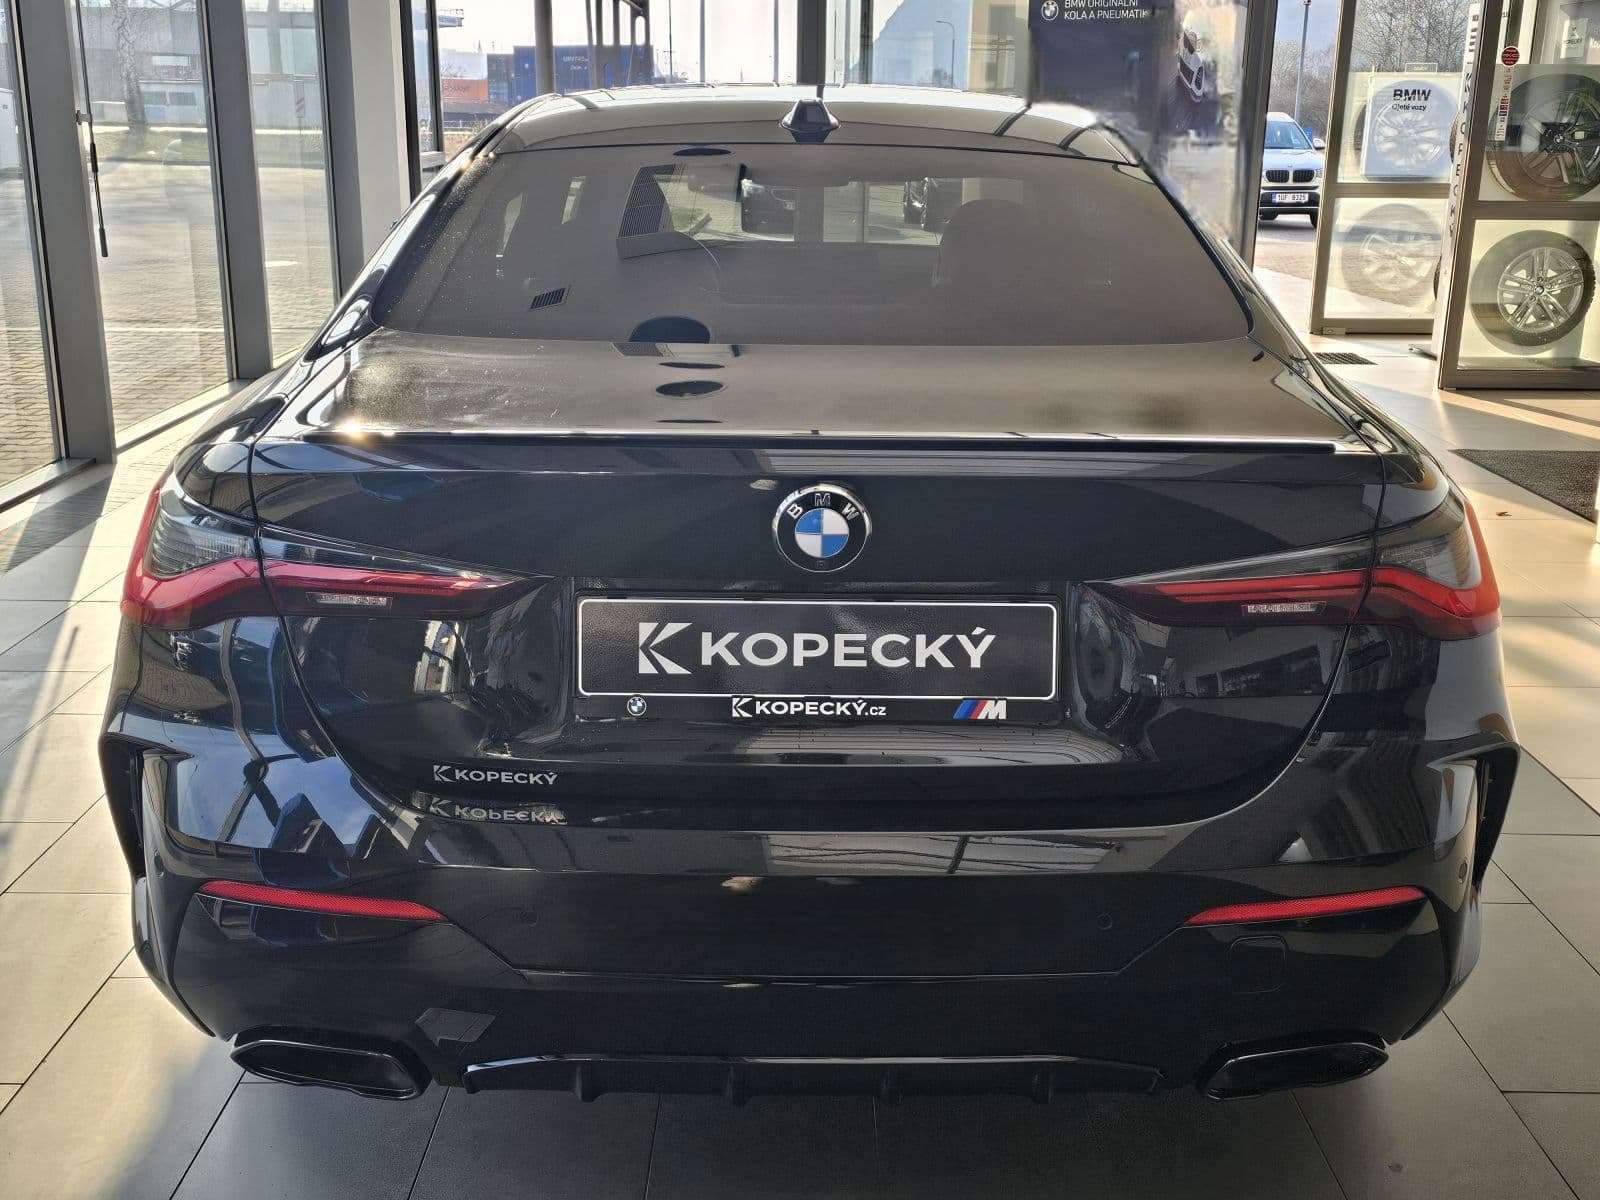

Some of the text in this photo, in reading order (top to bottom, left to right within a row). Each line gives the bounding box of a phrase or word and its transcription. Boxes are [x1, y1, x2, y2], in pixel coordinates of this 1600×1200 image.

[1064, 0, 1085, 8] BMW
[1064, 10, 1087, 20] KOLA
[1088, 10, 1096, 20] A
[1393, 88, 1431, 102] BMW
[786, 492, 860, 521] BMW
[701, 626, 996, 668] KOPECKÝ
[755, 699, 887, 716] KOPECKÝ.cz
[455, 769, 558, 785] KOPECKÝ
